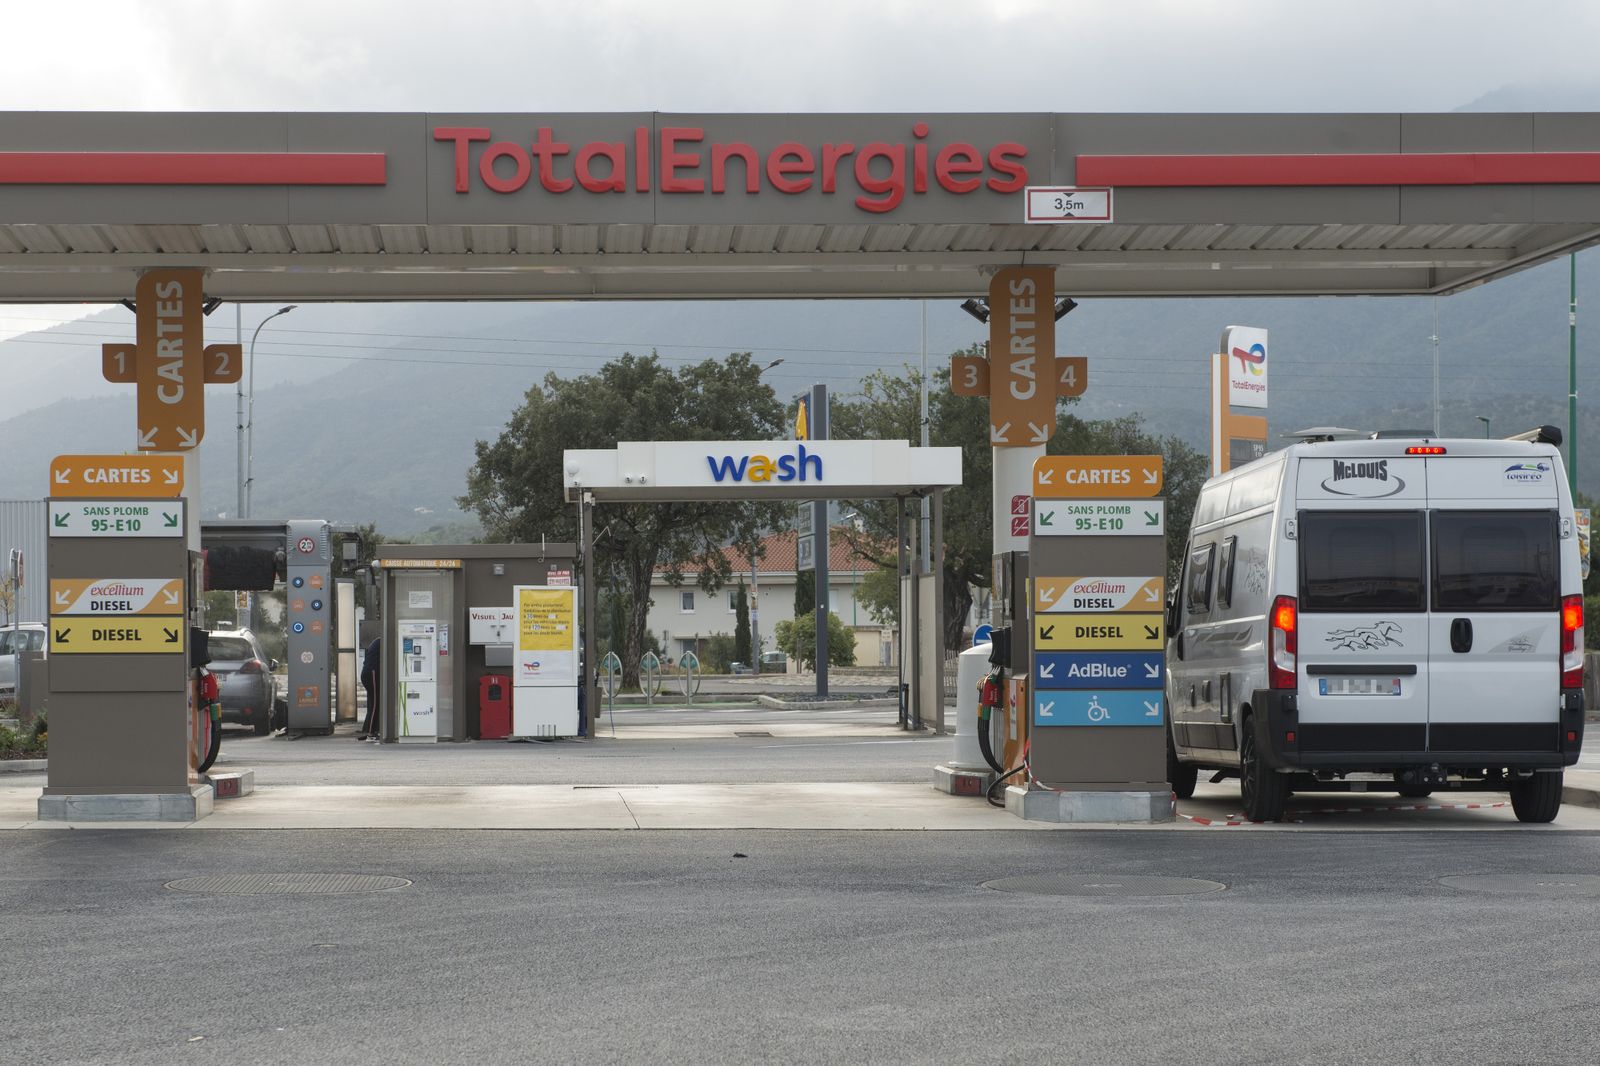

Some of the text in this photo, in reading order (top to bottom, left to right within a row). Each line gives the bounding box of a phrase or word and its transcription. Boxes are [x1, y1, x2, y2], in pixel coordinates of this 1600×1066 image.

[434, 122, 1028, 213] TotalEnergies
[1054, 197, 1084, 212] 3,5m
[157, 280, 184, 404] CARTES
[1009, 277, 1037, 401] CARTES
[113, 351, 125, 374] 1
[214, 352, 230, 375] 2
[963, 364, 978, 387] 3
[1060, 365, 1077, 387] 4
[1232, 380, 1266, 393] TotalEnergies
[707, 444, 823, 482] wash
[83, 468, 151, 483] CARTES
[1065, 469, 1131, 484] CARTES
[83, 507, 149, 516] SANS PLOMB
[1067, 506, 1131, 515] SANS PLOMB
[91, 519, 141, 532] 95-E10
[1075, 518, 1124, 531] 95-E10
[90, 583, 144, 597] excellium
[1073, 581, 1126, 594] excellium
[90, 601, 133, 612] DIESEL
[1073, 598, 1115, 609] DIESEL
[92, 629, 142, 642] DIESEL
[1075, 626, 1124, 639] DIESEL
